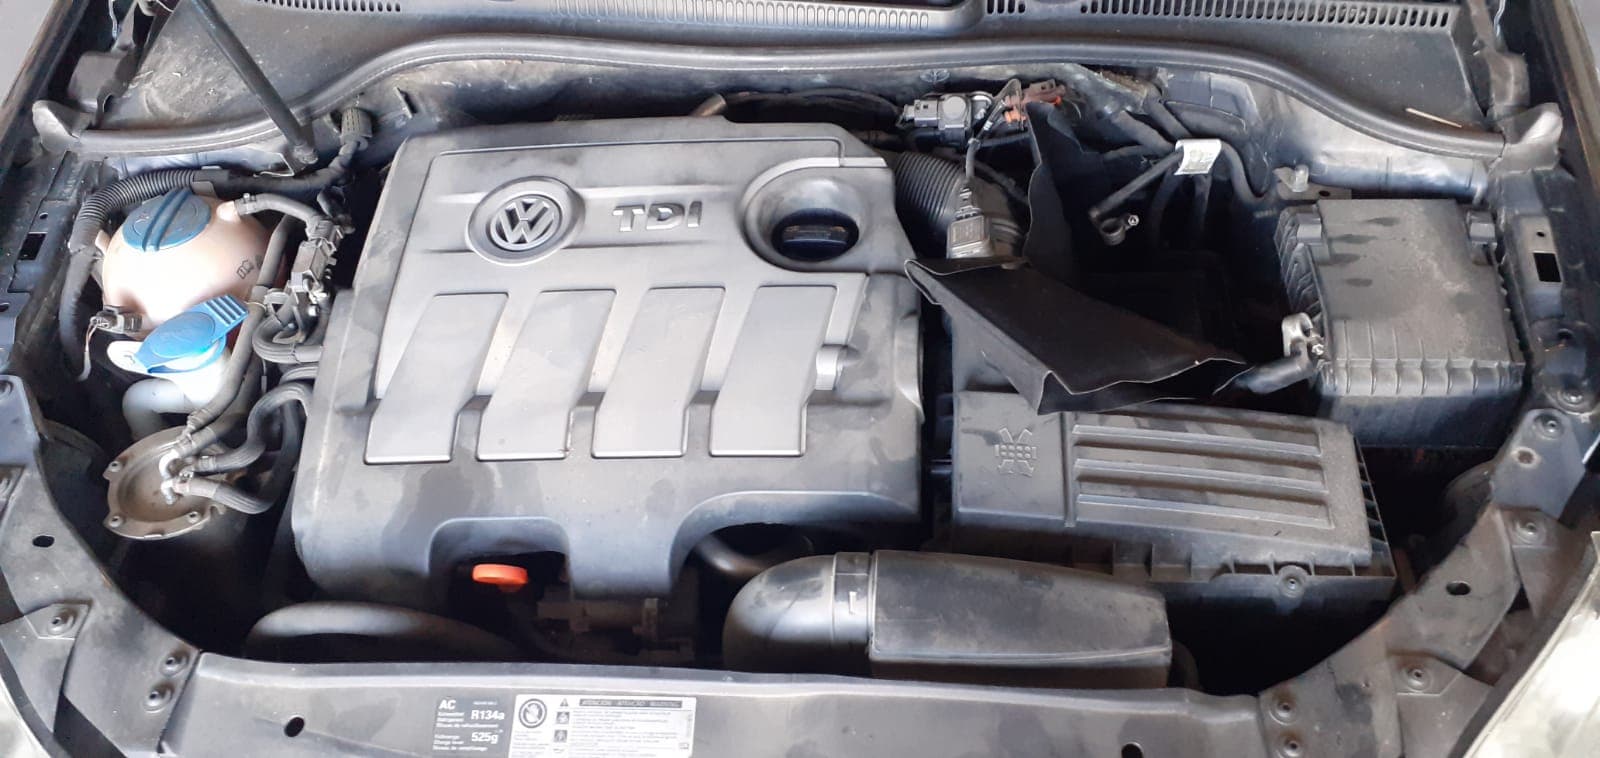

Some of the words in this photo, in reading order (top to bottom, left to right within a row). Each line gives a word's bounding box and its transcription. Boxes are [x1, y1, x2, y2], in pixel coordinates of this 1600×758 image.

[612, 200, 703, 232] TDI
[438, 699, 457, 710] AC
[471, 709, 505, 721] R134a
[471, 732, 499, 745] 525g
